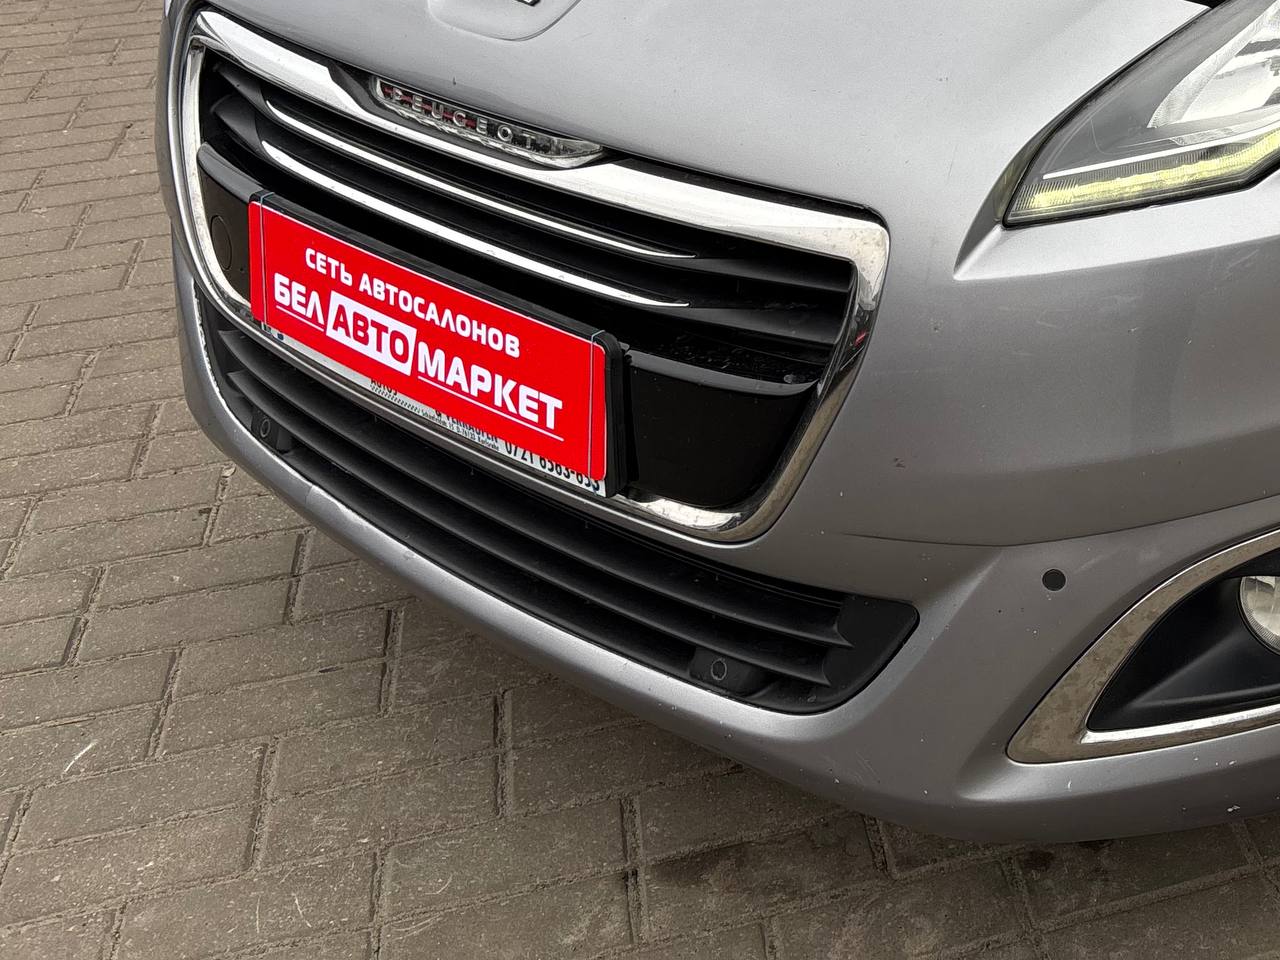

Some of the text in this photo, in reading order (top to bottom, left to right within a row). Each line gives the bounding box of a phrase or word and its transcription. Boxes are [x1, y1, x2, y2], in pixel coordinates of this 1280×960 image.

[392, 87, 535, 149] PEUGEOT
[305, 247, 520, 358] СЕТЬ АВТОСАЛОНОВ
[417, 341, 564, 430] МАРКЕТ
